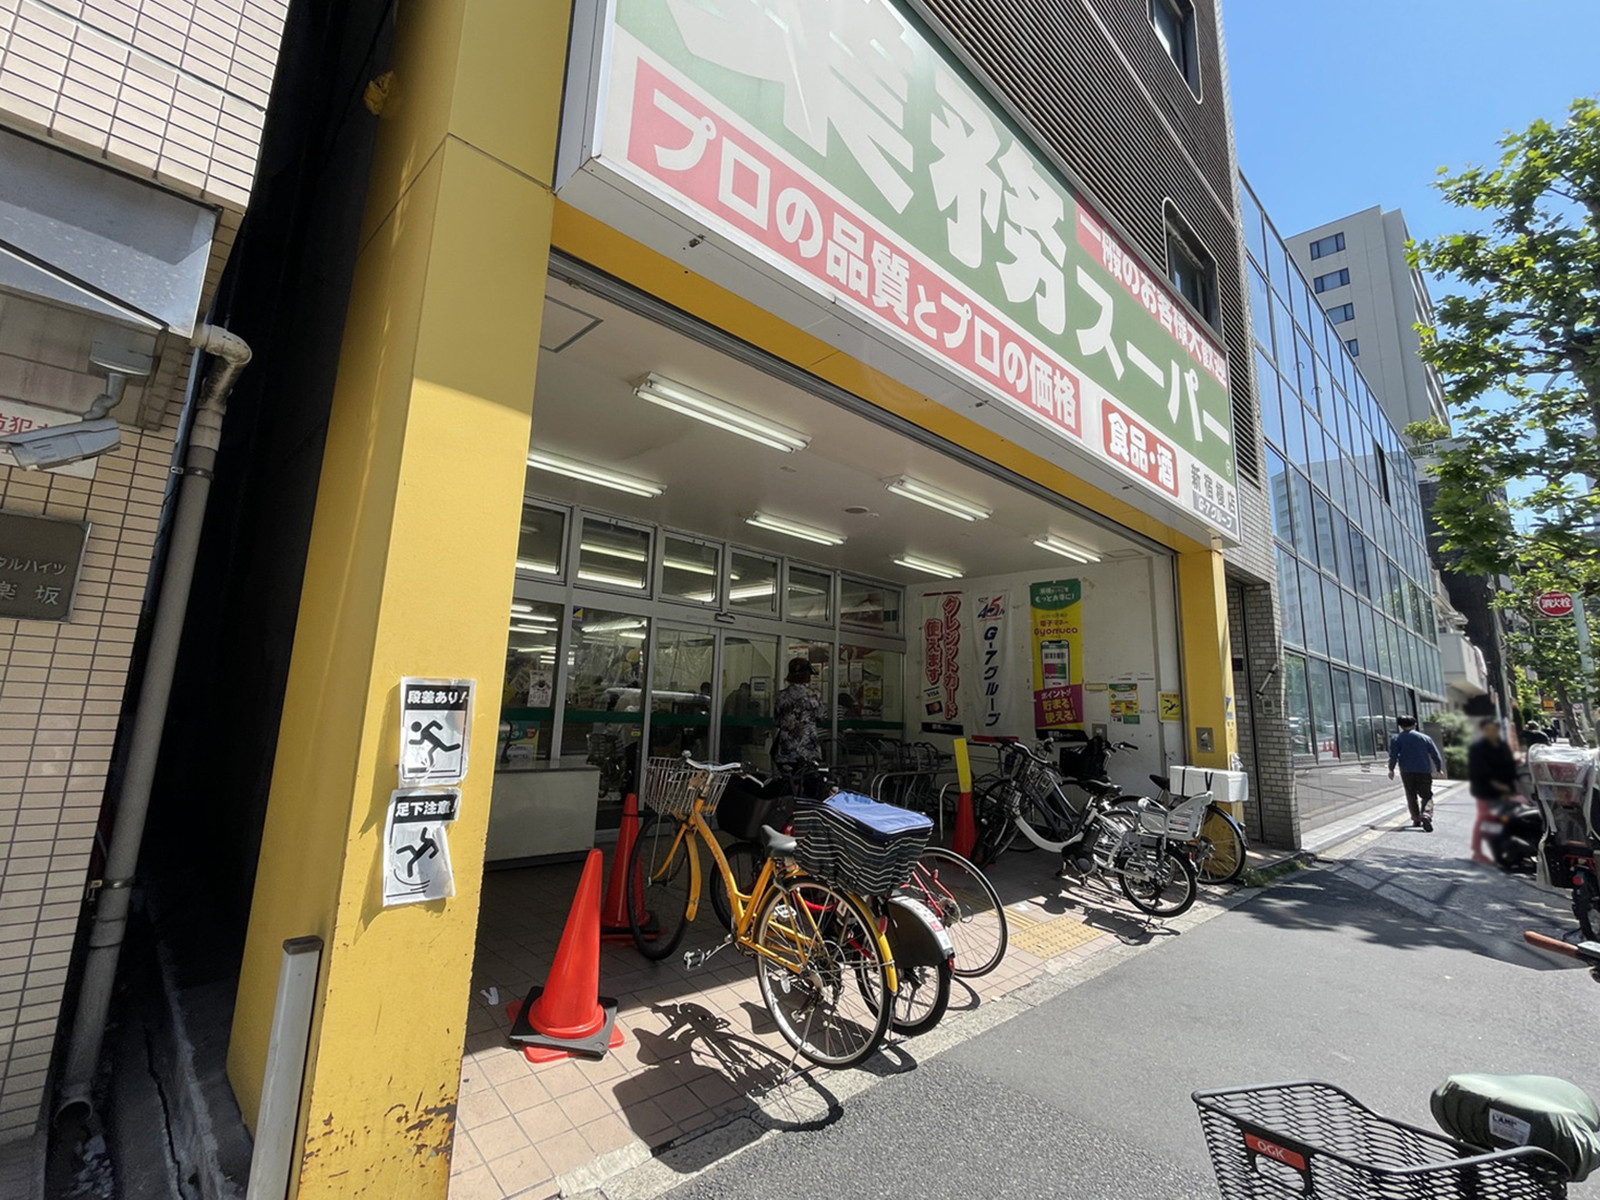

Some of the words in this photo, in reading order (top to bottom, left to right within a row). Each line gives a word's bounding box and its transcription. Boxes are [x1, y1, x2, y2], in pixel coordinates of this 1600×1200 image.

[653, 88, 1078, 430] プロの品質とプロの価格
[1108, 412, 1175, 491] 食品・酒
[1541, 597, 1571, 609] 消火栓
[925, 618, 943, 685] 使えます
[983, 626, 1000, 727] G-7グループ
[407, 690, 467, 704] 段差あり!
[1257, 1141, 1285, 1160] OGK
